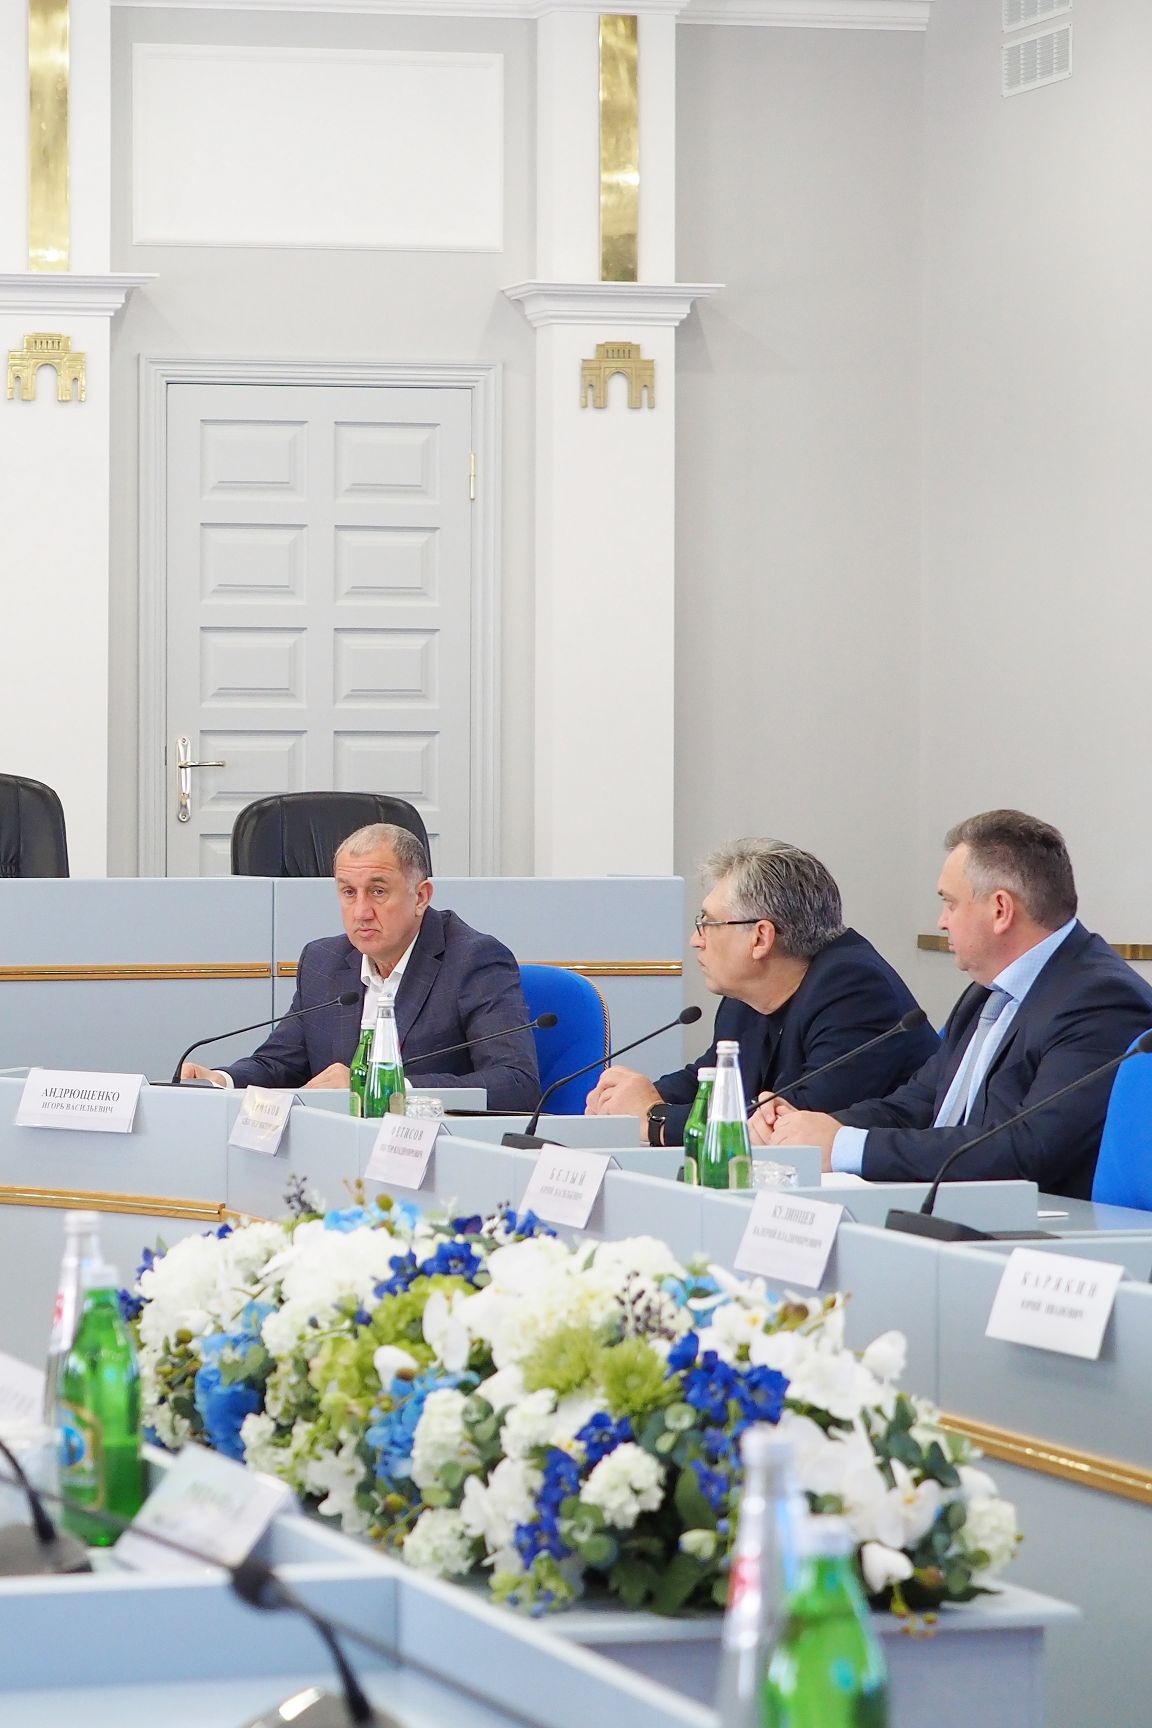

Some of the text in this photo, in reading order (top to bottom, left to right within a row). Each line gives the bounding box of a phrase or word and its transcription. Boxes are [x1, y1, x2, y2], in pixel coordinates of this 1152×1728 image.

[41, 1087, 120, 1102] АНДРЮЩЕНКО
[41, 1101, 114, 1113] ИГОРЬ ВАСИЛЬЕВИЧ
